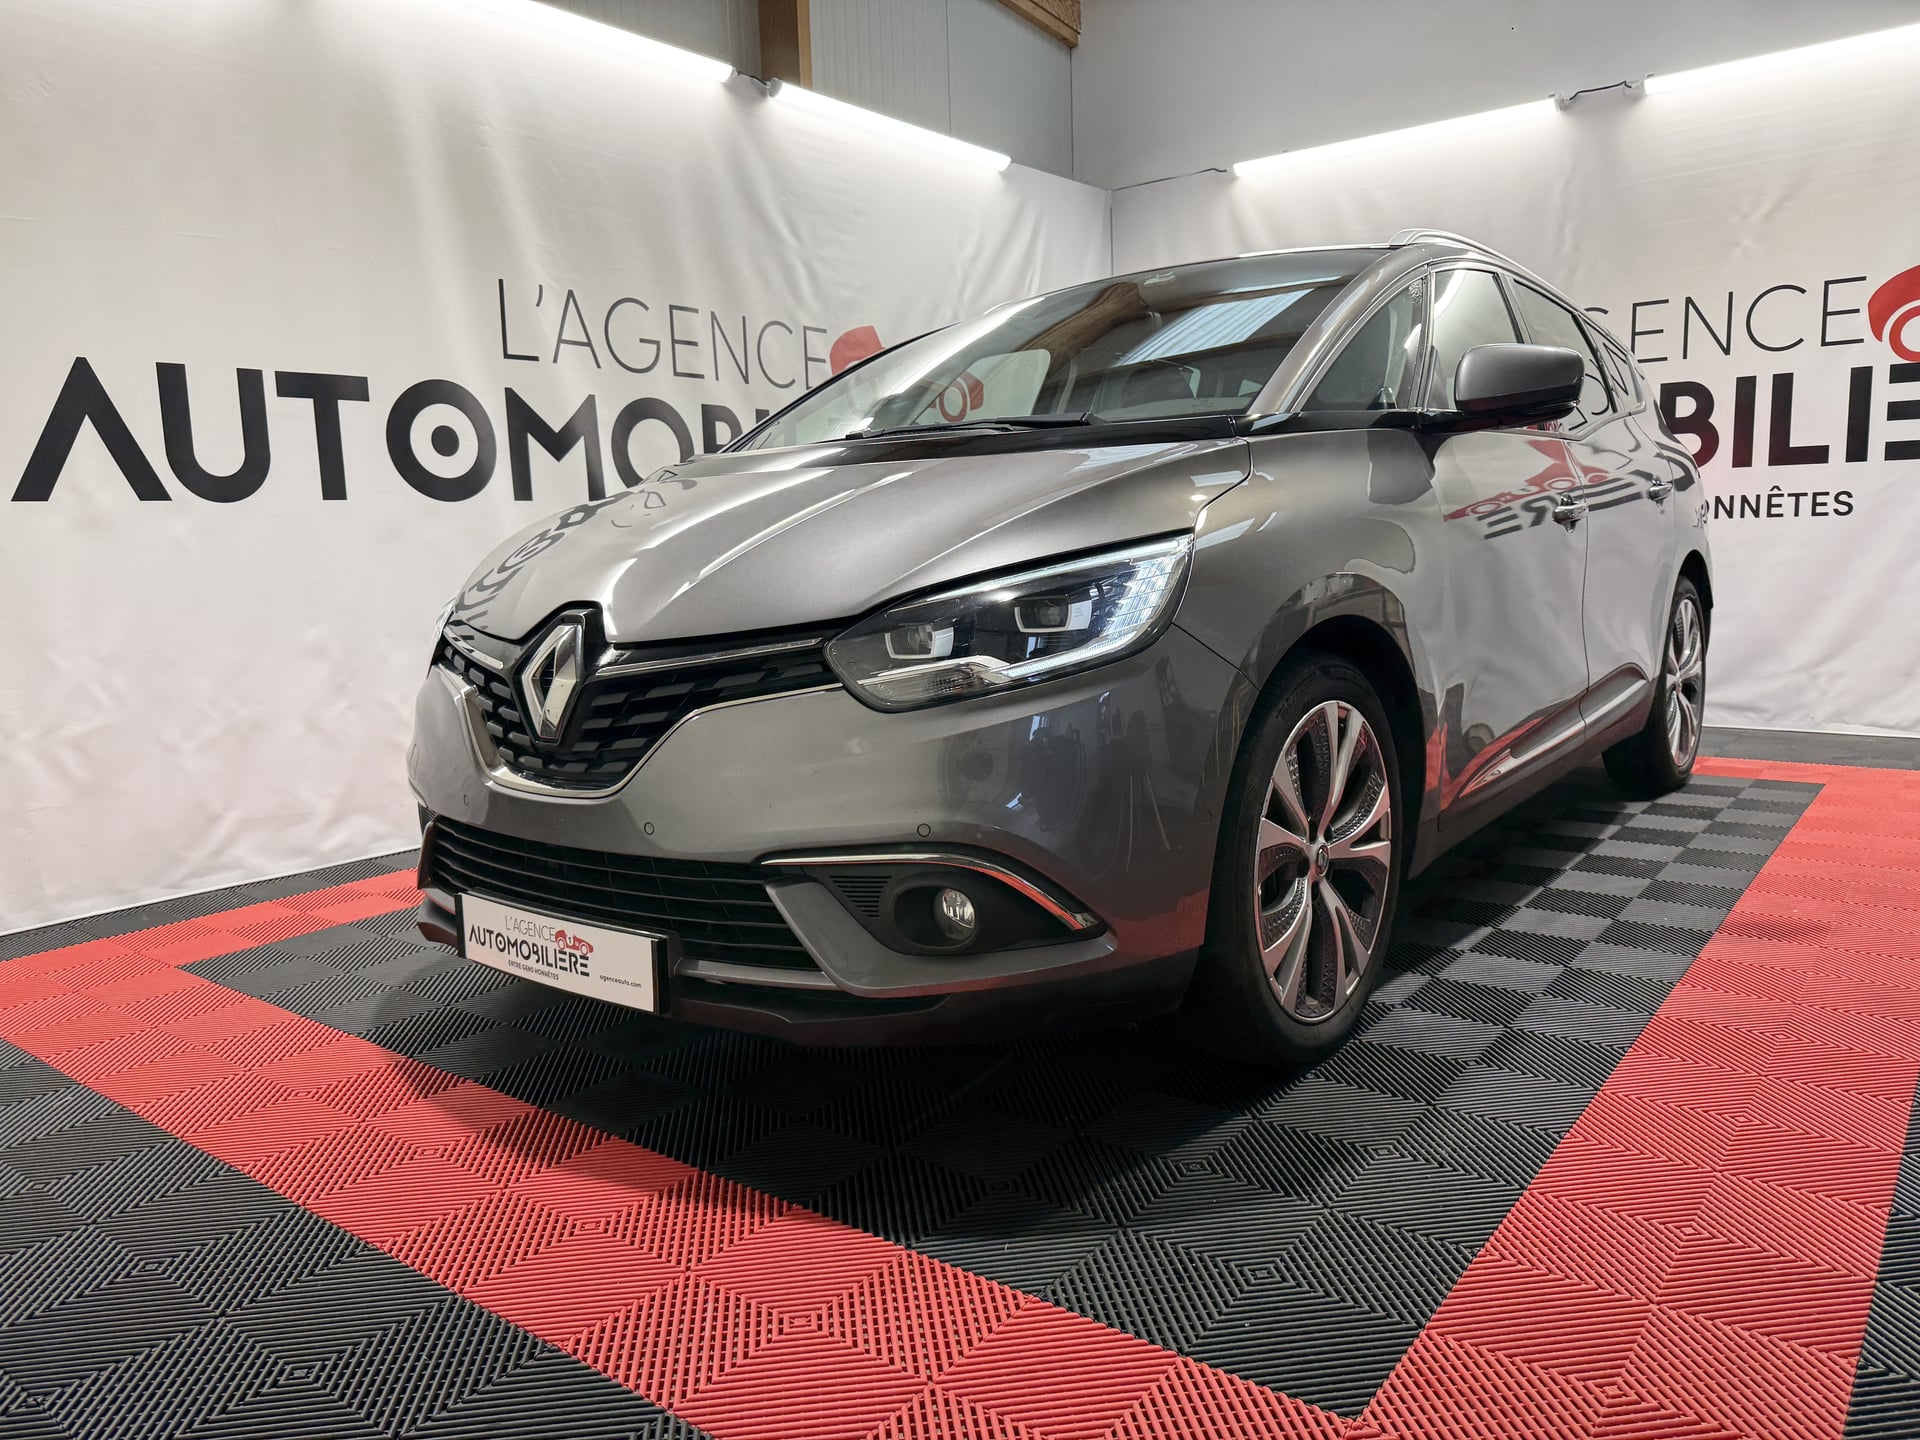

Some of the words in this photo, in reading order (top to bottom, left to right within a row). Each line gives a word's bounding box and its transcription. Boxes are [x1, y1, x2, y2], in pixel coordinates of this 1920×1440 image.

[498, 278, 827, 390] L'AGENCE
[1584, 276, 1867, 364] ENCE
[11, 356, 770, 503] AUTOMO
[1705, 485, 1854, 520] NNÊTES
[505, 914, 555, 943] L'AGENCE
